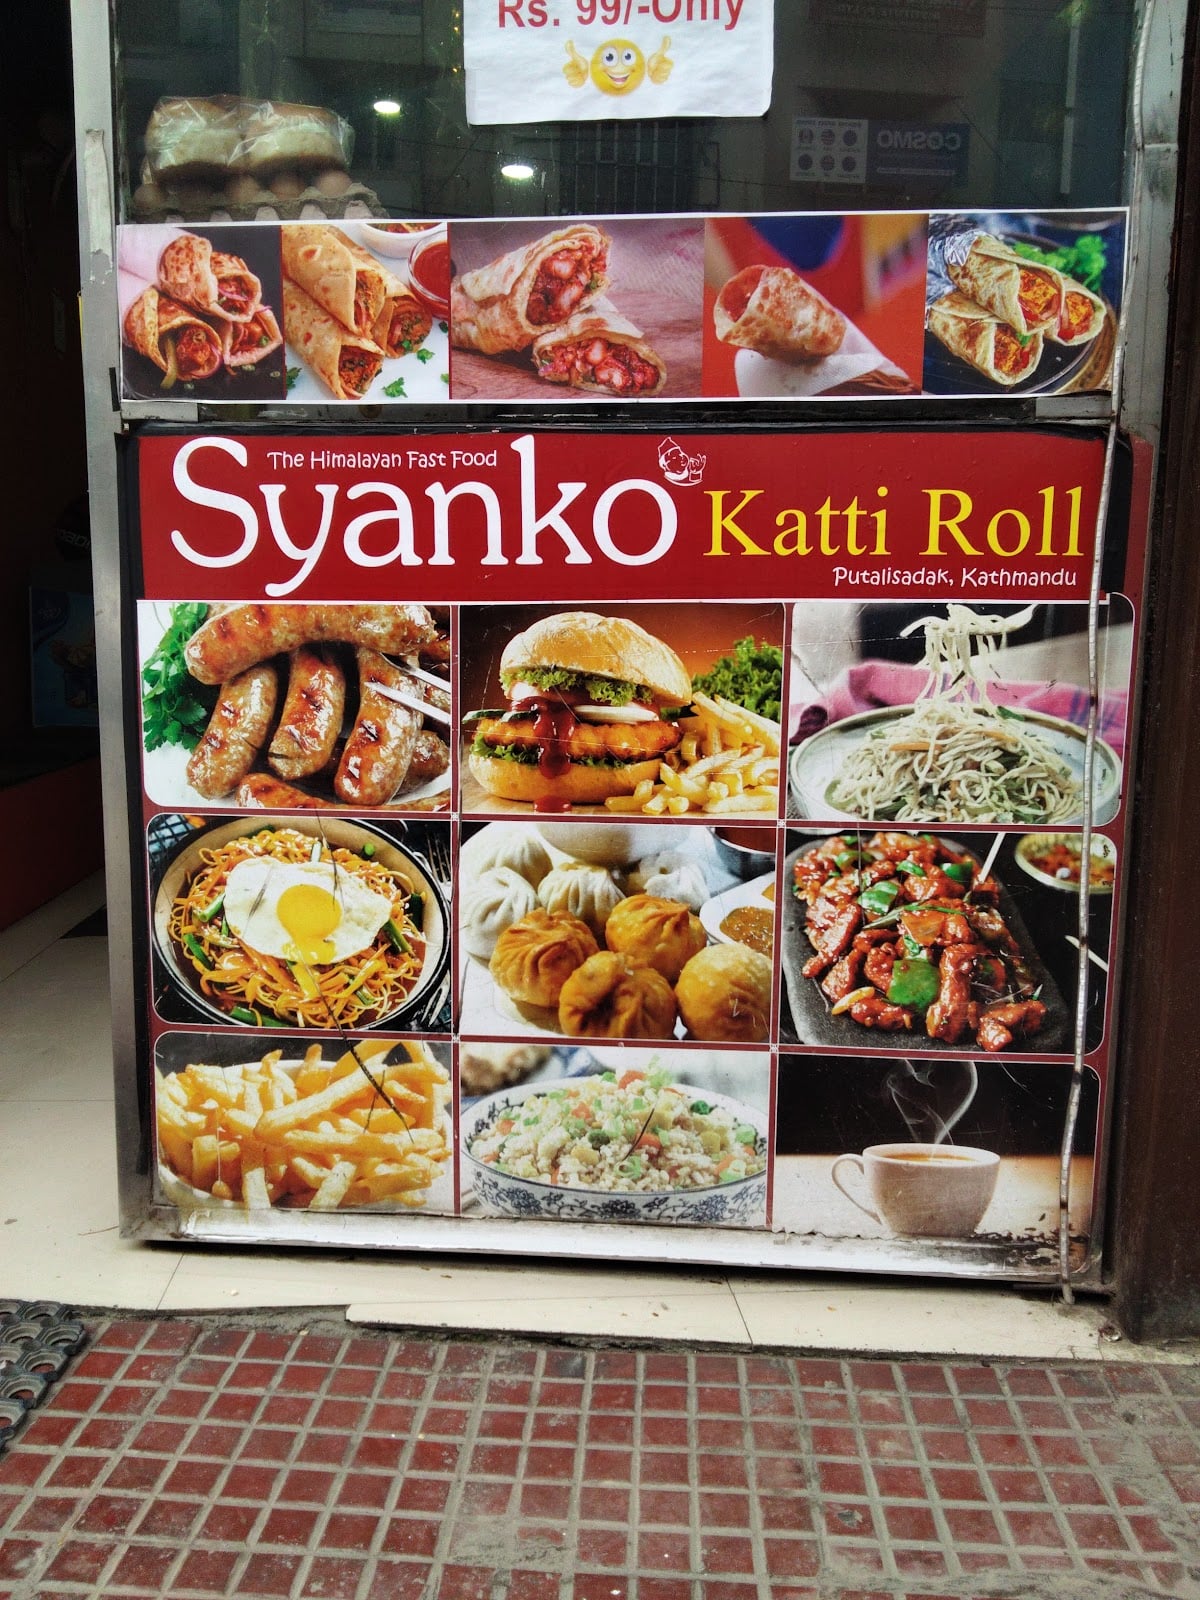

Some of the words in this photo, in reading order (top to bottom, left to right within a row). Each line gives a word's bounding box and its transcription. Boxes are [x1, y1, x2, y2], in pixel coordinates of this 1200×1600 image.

[498, 0, 560, 28] Rs.
[266, 451, 305, 470] The
[310, 450, 402, 470] Himalayan
[406, 449, 447, 469] Fast
[449, 449, 497, 468] Food
[170, 434, 678, 598] Syanko
[702, 486, 891, 557] Katti
[918, 485, 1084, 557] Roll
[832, 566, 954, 588] Putalisadak,
[960, 566, 1077, 588] Kathmandu
